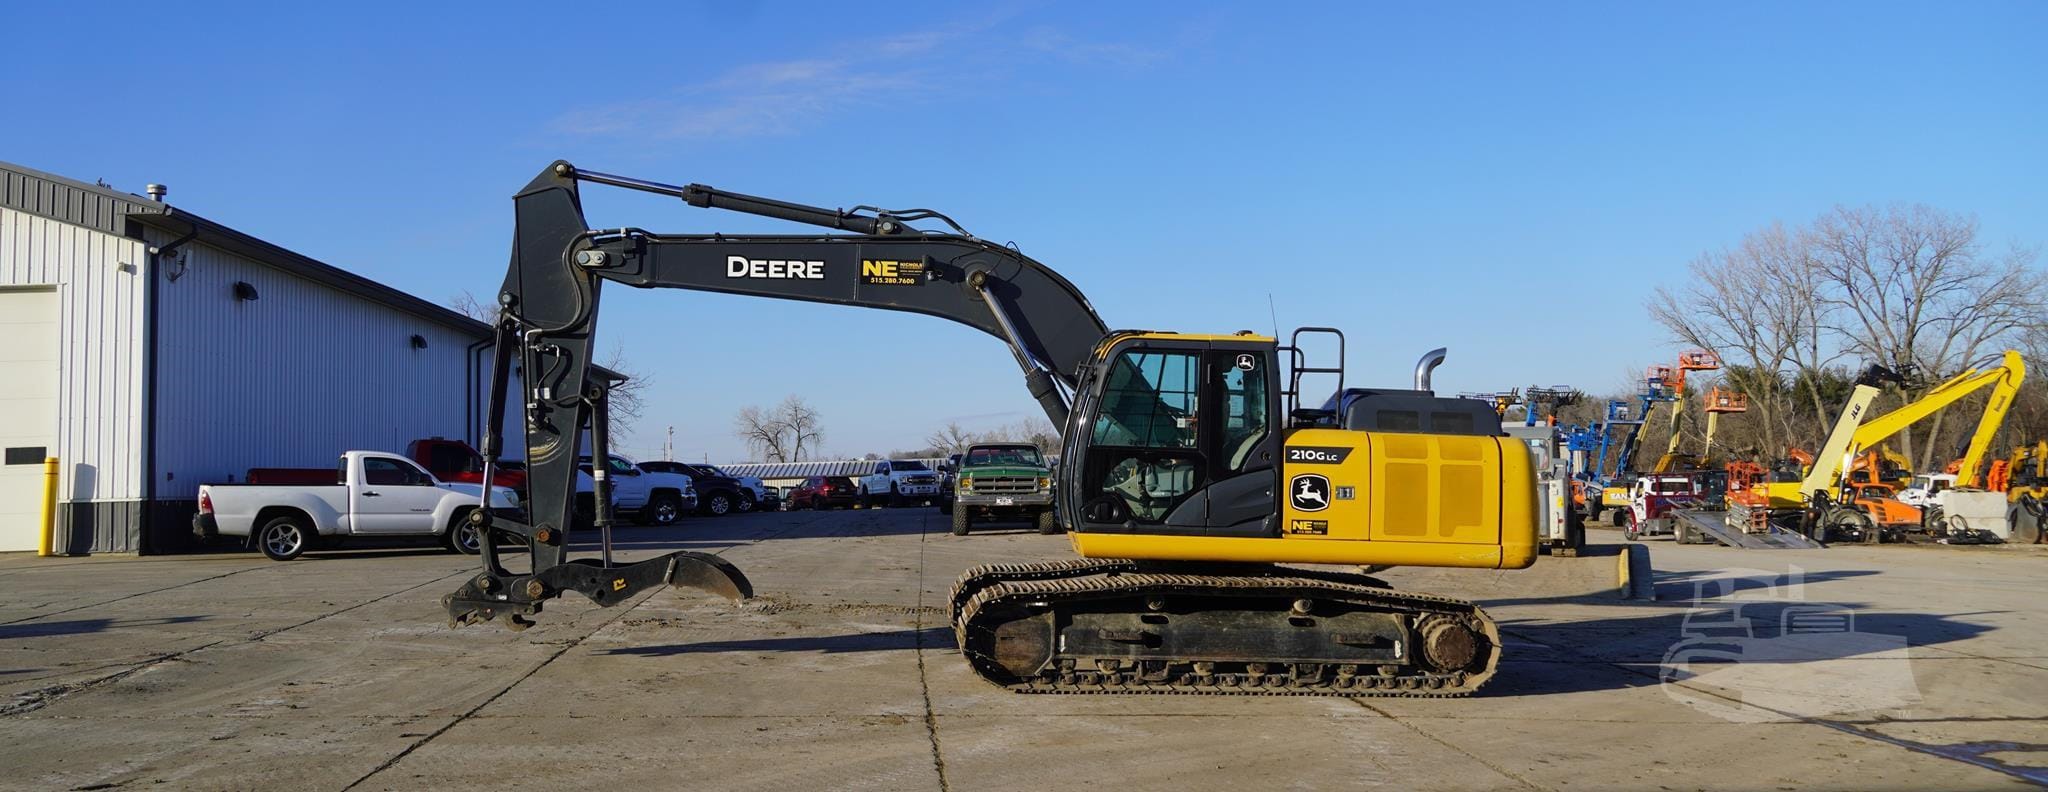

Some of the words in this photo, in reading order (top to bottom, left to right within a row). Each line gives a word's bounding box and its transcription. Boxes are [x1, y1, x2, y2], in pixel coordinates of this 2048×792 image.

[727, 256, 824, 279] DEERE
[863, 260, 898, 277] NE
[1851, 403, 1861, 420] JLG
[1291, 450, 1325, 460] 210G
[1292, 521, 1313, 530] NE
